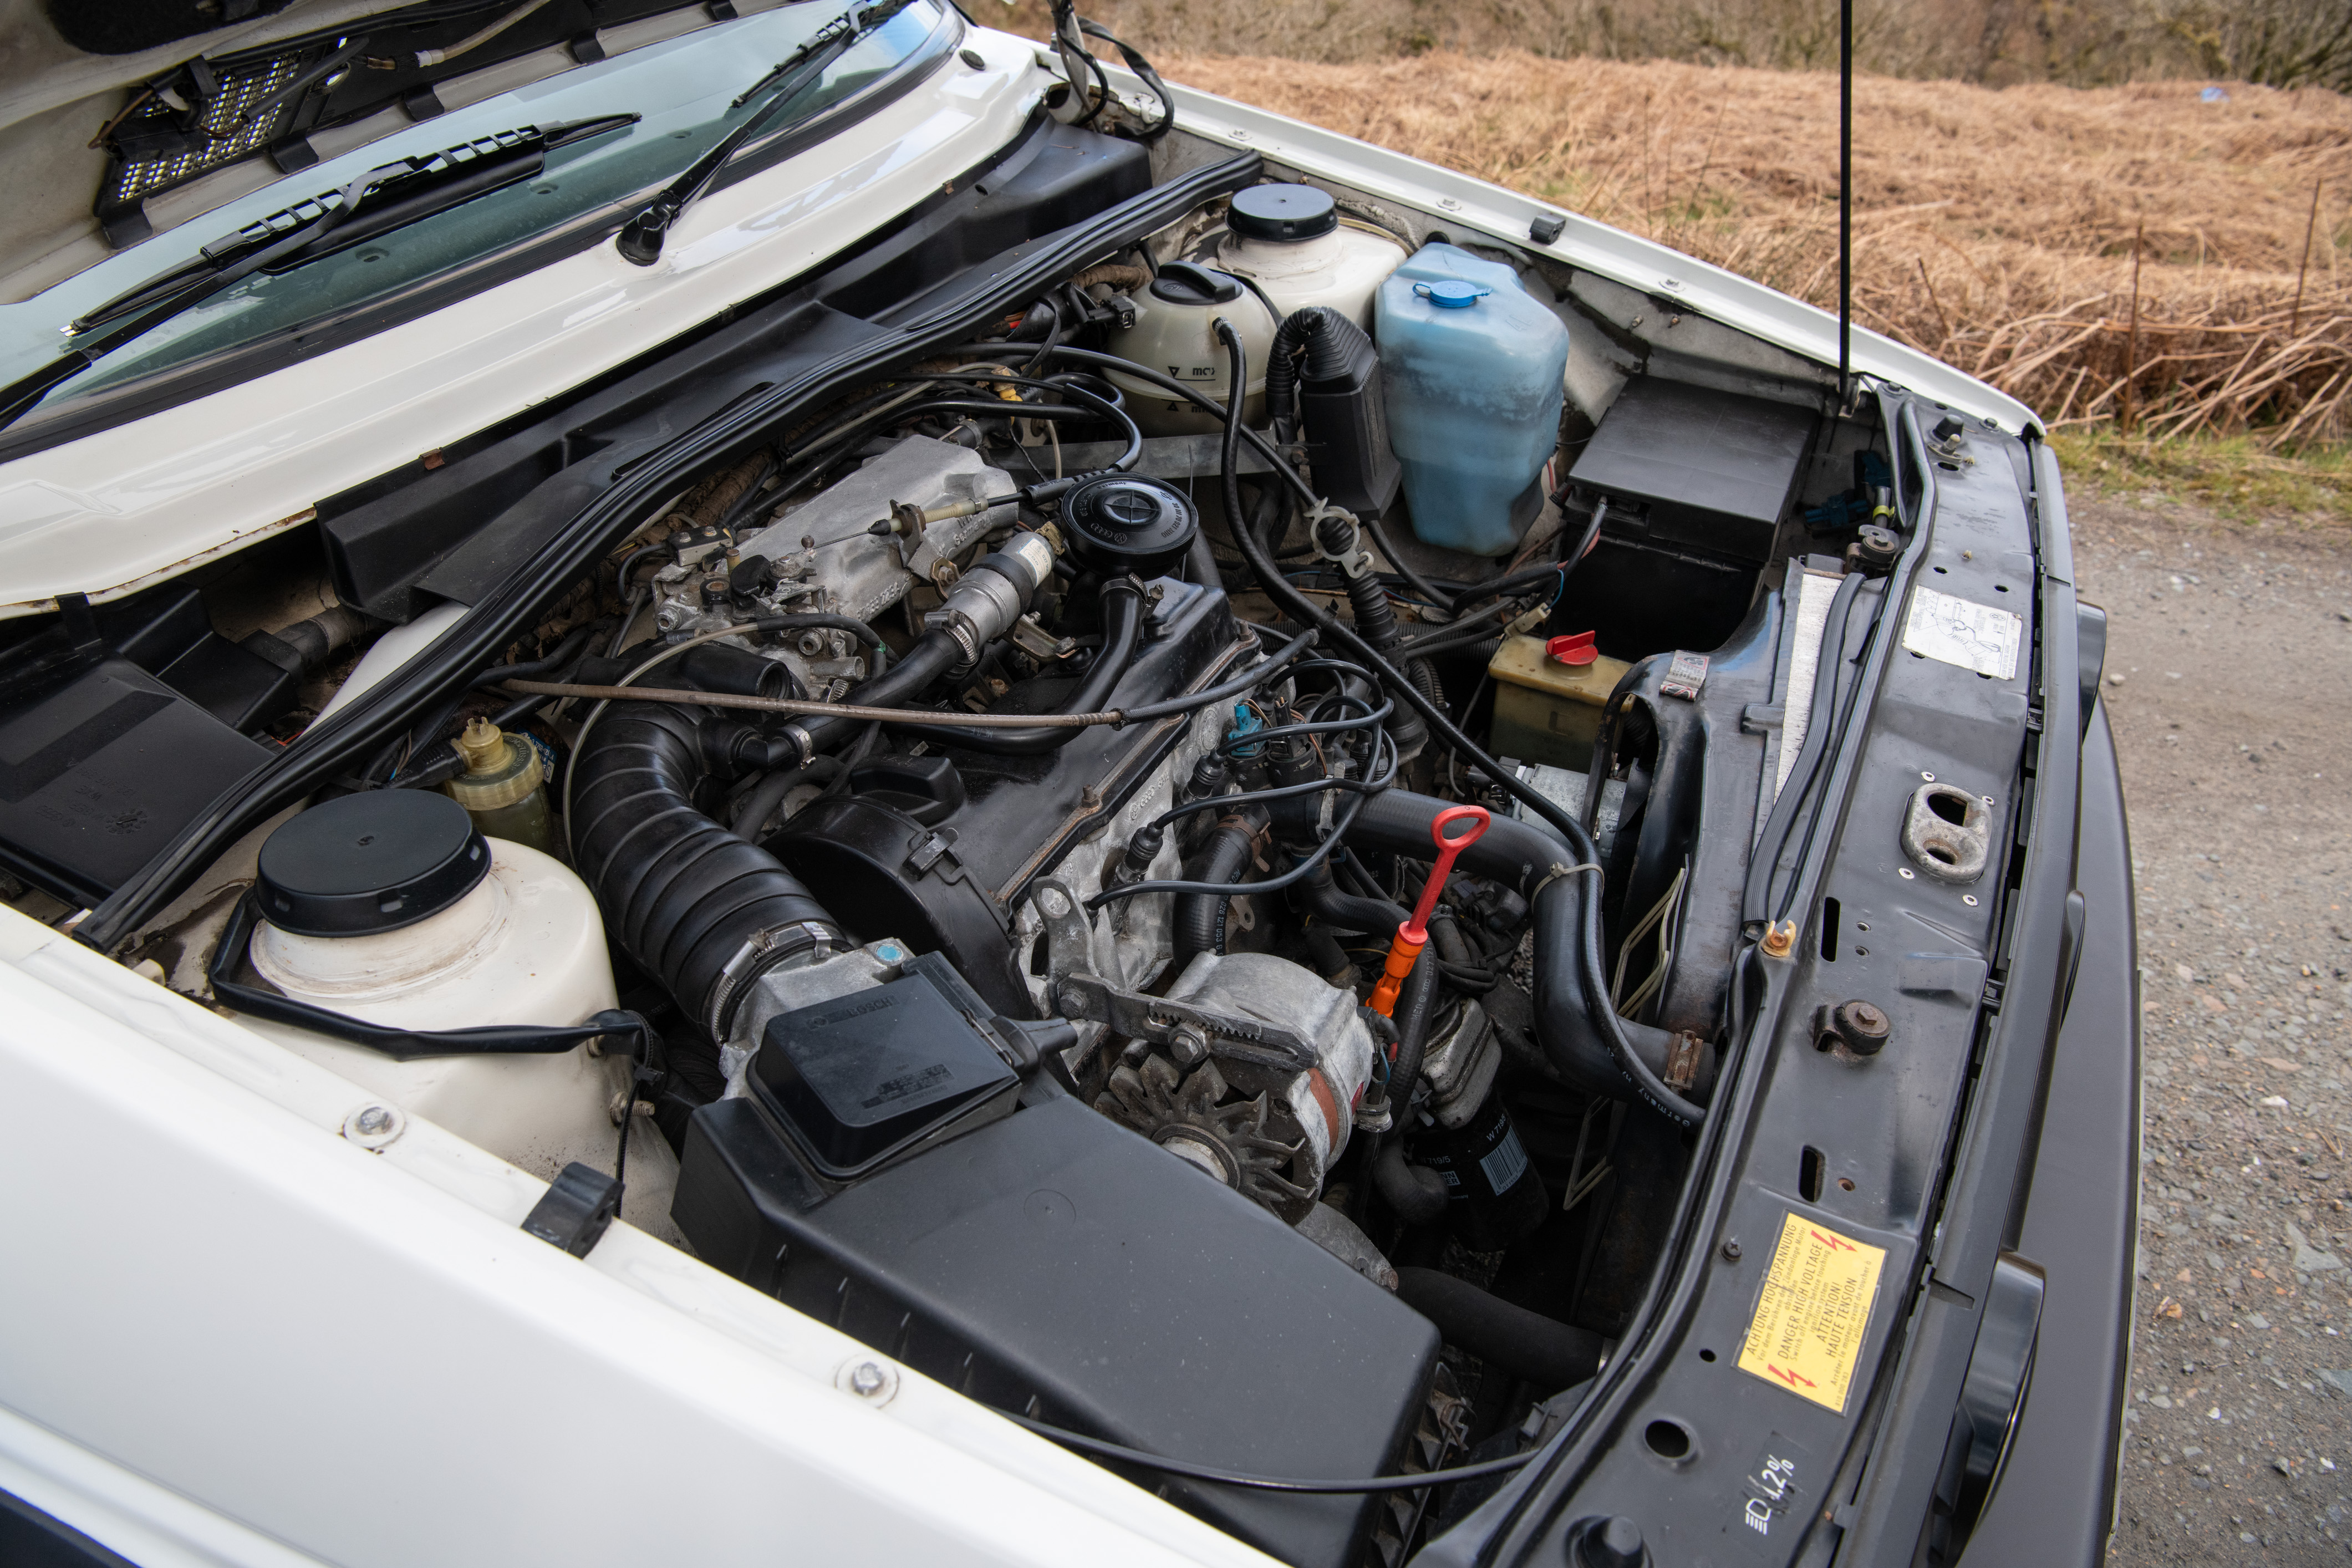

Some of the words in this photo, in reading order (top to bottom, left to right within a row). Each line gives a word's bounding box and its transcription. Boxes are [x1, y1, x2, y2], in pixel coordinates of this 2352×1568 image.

[847, 997, 893, 1016] BOSCH
[1637, 1087, 1691, 1127] Germany
[1486, 1129, 1495, 1141] W
[1494, 1114, 1506, 1135] 719/5
[1427, 1155, 1450, 1164] 719/5
[1795, 1226, 1807, 1245] Motor
[1783, 1245, 1800, 1282] Zündanlage
[1816, 1249, 1831, 1277] touching
[1745, 1305, 1770, 1355] ACHTUNG
[1763, 1223, 1797, 1303] HOCHSPANNUNG
[1778, 1284, 1788, 1297] der
[1809, 1277, 1822, 1301] before
[1857, 1266, 1870, 1291] toucher
[1776, 1315, 1800, 1359] DANGER
[1791, 1287, 1809, 1314] HIGH
[1800, 1243, 1822, 1286] VOLTAGE
[1783, 1279, 1798, 1310] abstellen
[1808, 1304, 1823, 1332] ignition
[1817, 1281, 1830, 1305] system
[1854, 1291, 1863, 1301] de
[1766, 1298, 1783, 1331] Berühren
[1801, 1300, 1815, 1324] engine
[1815, 1281, 1842, 1342] ATTENTION!
[1825, 1321, 1844, 1357] HAUTE
[1836, 1277, 1857, 1319] TENSION
[1848, 1301, 1860, 1321] avant
[1850, 1305, 1868, 1343] l'allumage
[1761, 1332, 1772, 1348] dem
[1798, 1325, 1807, 1336] off
[1840, 1322, 1854, 1349] moteur
[1757, 1348, 1766, 1361] Vor
[1790, 1337, 1803, 1361] Switch
[1838, 1349, 1846, 1357] le
[1830, 1357, 1844, 1386] Arrêter
